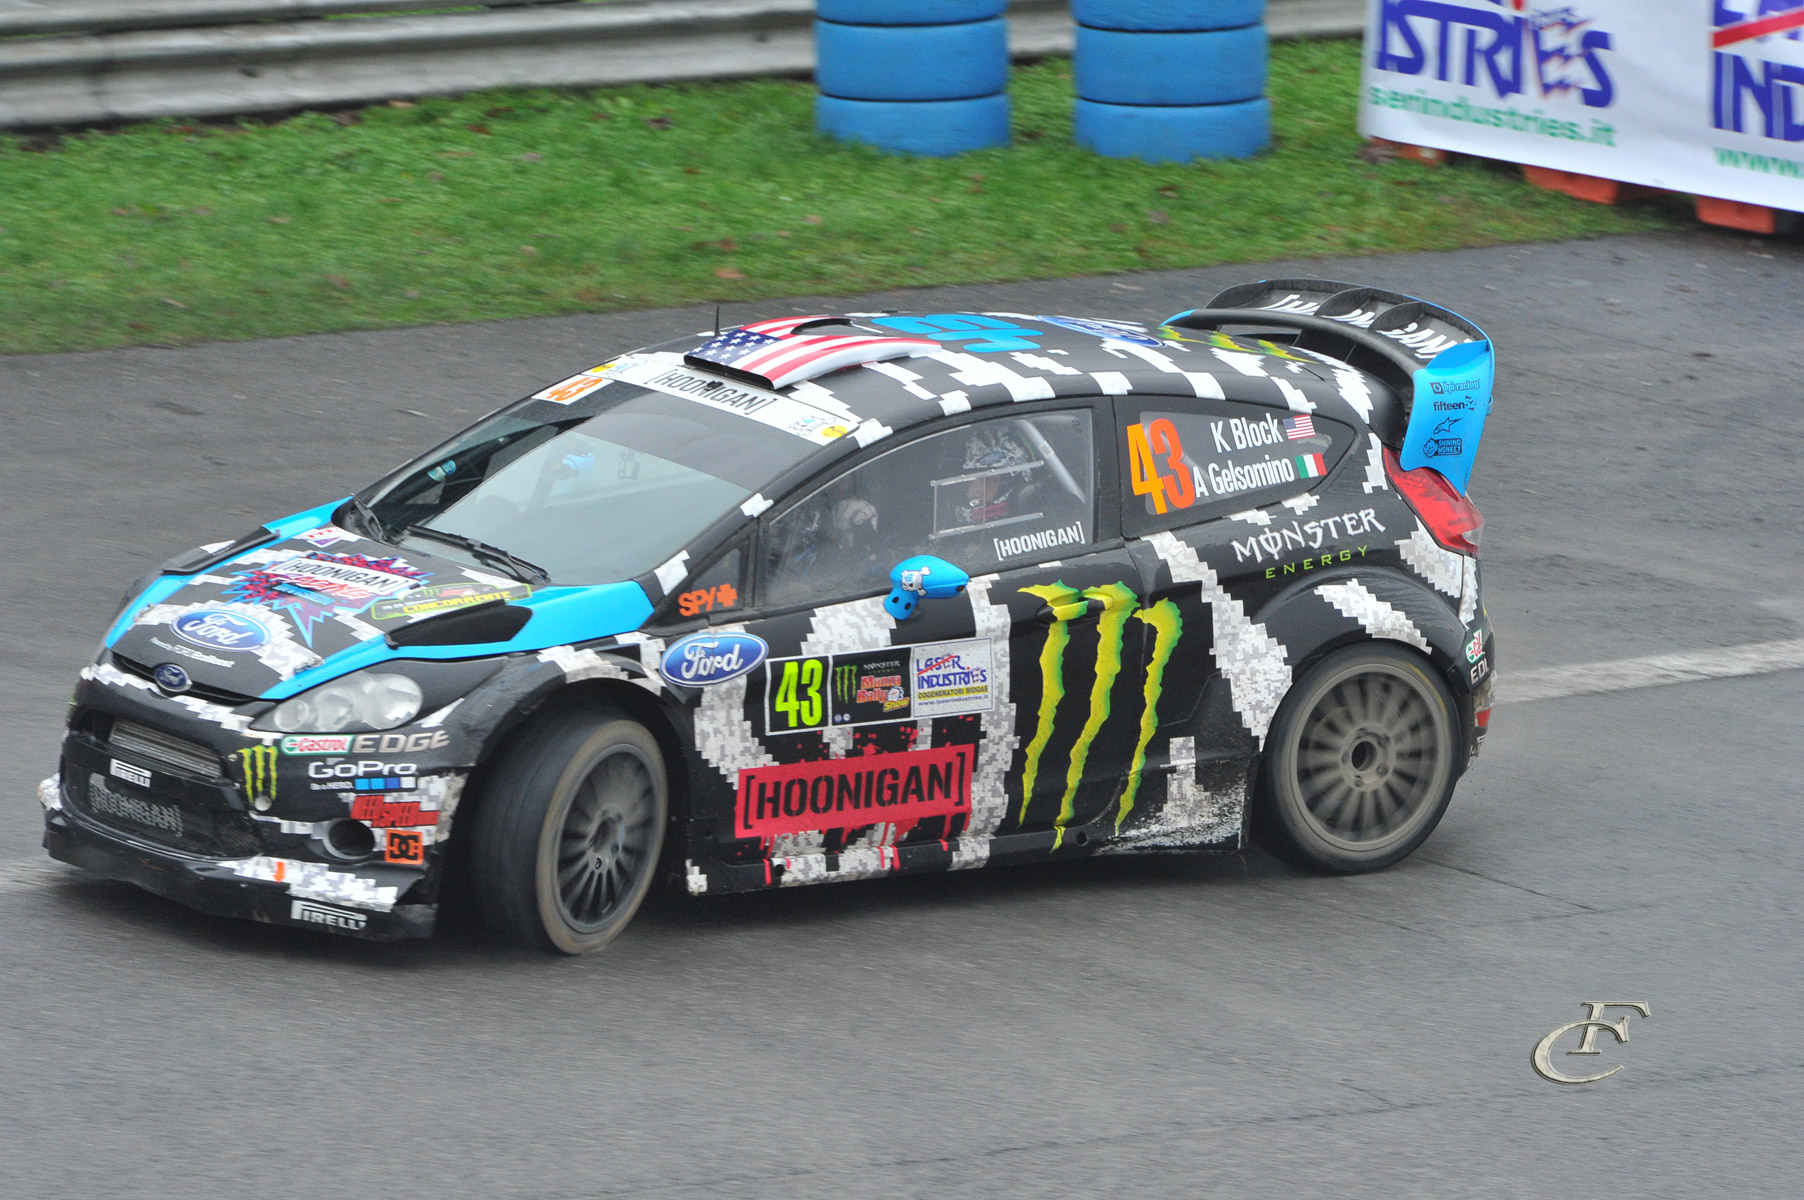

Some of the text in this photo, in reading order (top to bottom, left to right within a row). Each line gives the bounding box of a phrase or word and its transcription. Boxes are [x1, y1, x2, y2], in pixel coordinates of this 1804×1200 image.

[1373, 0, 1614, 108] STRIES
[1210, 413, 1284, 453] K Block
[1127, 418, 1196, 515] 43
[1192, 454, 1295, 498] A Gelsomino
[1231, 507, 1386, 563] MONSTER
[1265, 545, 1368, 579] ENERGY
[180, 612, 257, 646] Ford
[677, 636, 748, 680] Ford
[775, 659, 823, 728] 43
[856, 688, 889, 704] Rally
[917, 667, 988, 690] INDUSTRIES
[299, 730, 450, 753] Castrol EDGE
[308, 760, 418, 778] GoPro
[291, 900, 367, 930] PIRELLI
